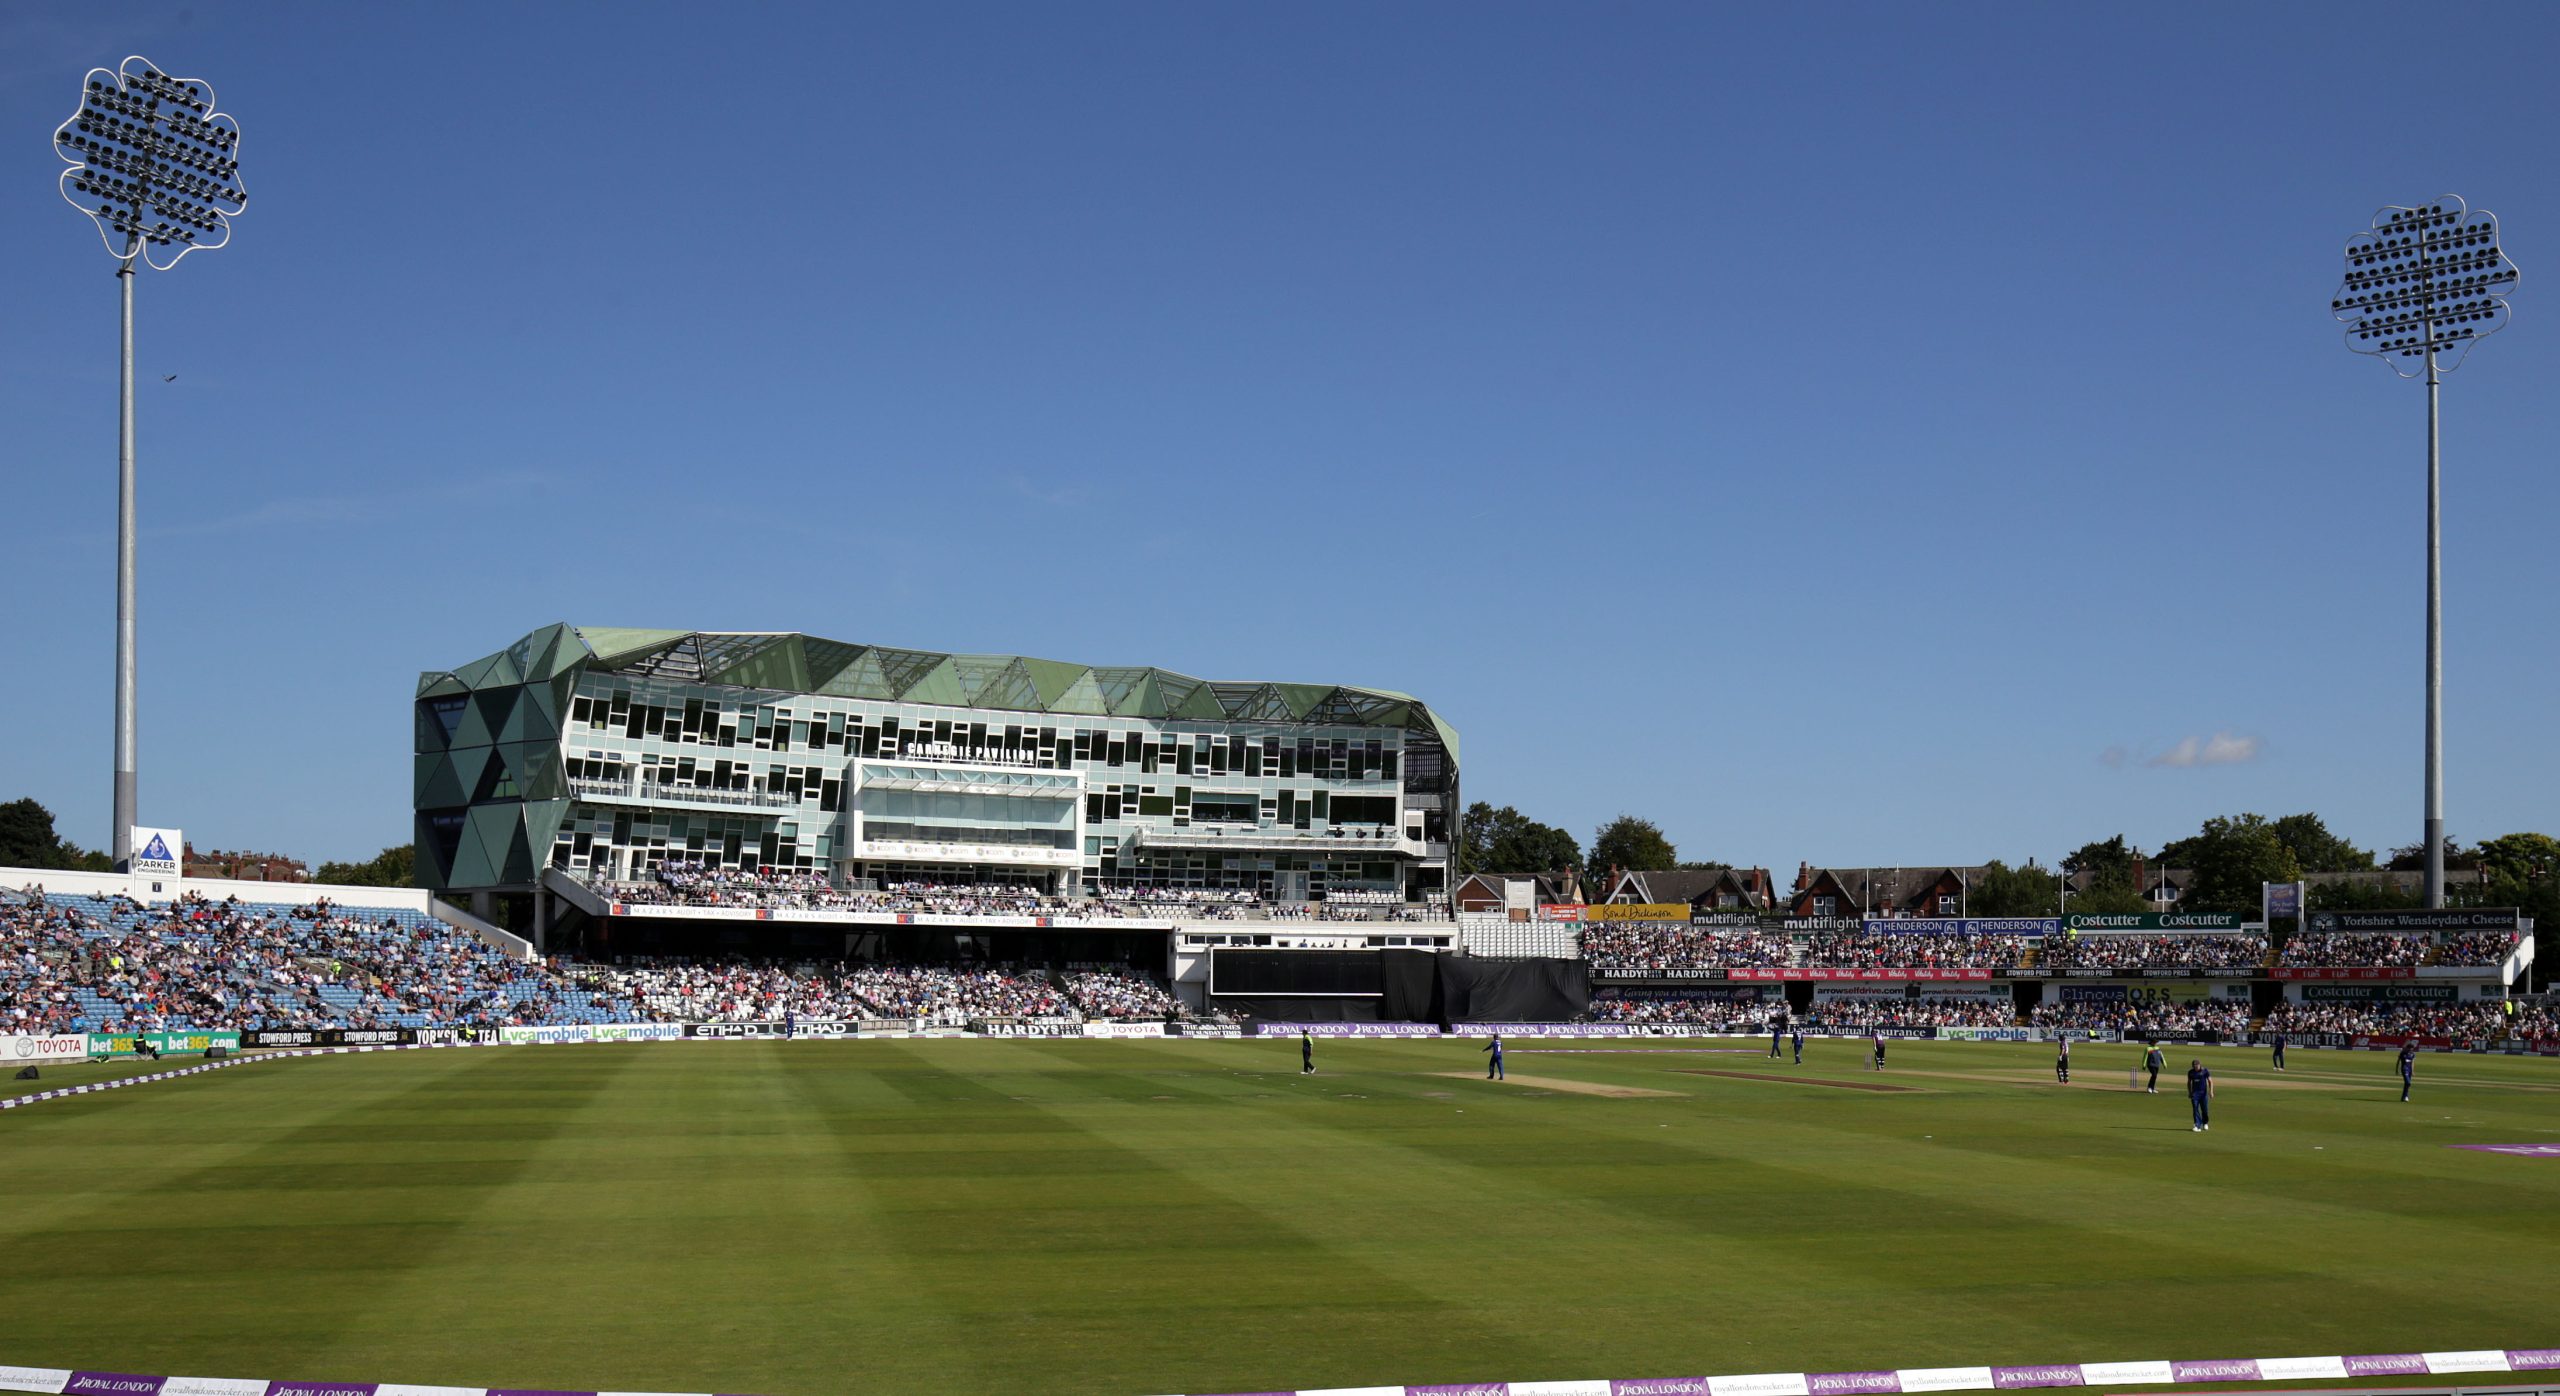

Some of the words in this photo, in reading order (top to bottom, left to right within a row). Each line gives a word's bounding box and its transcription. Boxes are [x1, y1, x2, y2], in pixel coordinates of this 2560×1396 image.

[908, 742, 971, 757] CARNEGIE
[976, 747, 1034, 760] PAVILION
[138, 860, 176, 869] PARKER
[1603, 905, 1627, 920] Bond
[1629, 905, 1674, 919] Dickinson
[1693, 913, 1756, 926] multiflight
[1784, 917, 1860, 931] multiflight
[2070, 915, 2141, 928] Costcutter
[2159, 914, 2231, 926] Costcutter
[2343, 915, 2395, 926] Yorkshire
[2398, 914, 2469, 927] Wensleydale
[2472, 914, 2513, 925] Cheese
[1884, 922, 1941, 931] HENDERSON
[1980, 921, 2041, 931] HENDERSON
[1605, 969, 1648, 978] HARDYS
[1667, 969, 1710, 978] HARDYS
[1817, 986, 1903, 995] arrowselfdrive.com
[2061, 988, 2125, 1000] Clinova
[2308, 986, 2371, 998] Costcutter
[2386, 986, 2450, 998] Costcutter
[501, 1026, 588, 1043] Lycamobile
[592, 1024, 680, 1040] Lycamobile
[696, 1024, 758, 1036] ETIHAD
[987, 1025, 1059, 1035] HARDYS
[1110, 1026, 1157, 1034] TOYOTA
[1271, 1025, 1301, 1035] ROYAL
[1303, 1025, 1348, 1035] LONDON
[1361, 1025, 1393, 1035] ROYAL
[1395, 1025, 1438, 1035] LONDON
[1464, 1025, 1496, 1035] ROYAL
[1496, 1025, 1538, 1035] LONDON
[1552, 1025, 1582, 1035] ROYAL
[1584, 1025, 1625, 1035] LONDON
[1827, 1026, 1865, 1035] Mutual
[1869, 1027, 1926, 1038] Isurance
[1938, 1028, 2029, 1041] Lycamobile
[2054, 1030, 2114, 1039] BAGNLS
[2145, 1031, 2197, 1039] HARROGATE
[259, 1032, 292, 1044] STOWFORD
[293, 1032, 311, 1043] PRESS
[344, 1031, 377, 1042] STOWFORD
[378, 1031, 397, 1041] PRESS
[416, 1030, 475, 1045] YORKSH
[478, 1029, 498, 1043] TEA
[2258, 1033, 2320, 1045] YORSHIRE
[2324, 1034, 2346, 1045] TEA
[36, 1039, 82, 1054] TOYOTA
[91, 1037, 163, 1053] bet365.m
[169, 1036, 237, 1050] bet365.com
[2356, 1361, 2382, 1370] ROYAL
[2383, 1359, 2421, 1368] LONDON
[2519, 1356, 2547, 1364] ROYAL
[2006, 1372, 2036, 1382] ROYAL
[2037, 1370, 2078, 1381] LONDON
[2184, 1367, 2213, 1377] ROYAL
[2215, 1365, 2254, 1375] LONDON
[82, 1379, 110, 1389] ROYAL
[112, 1380, 154, 1392] LONDON
[1625, 1385, 1657, 1395] ROYAL
[1659, 1383, 1703, 1393] LONDON
[1820, 1379, 1850, 1389] ROYAL
[1852, 1377, 1894, 1387] LONDON
